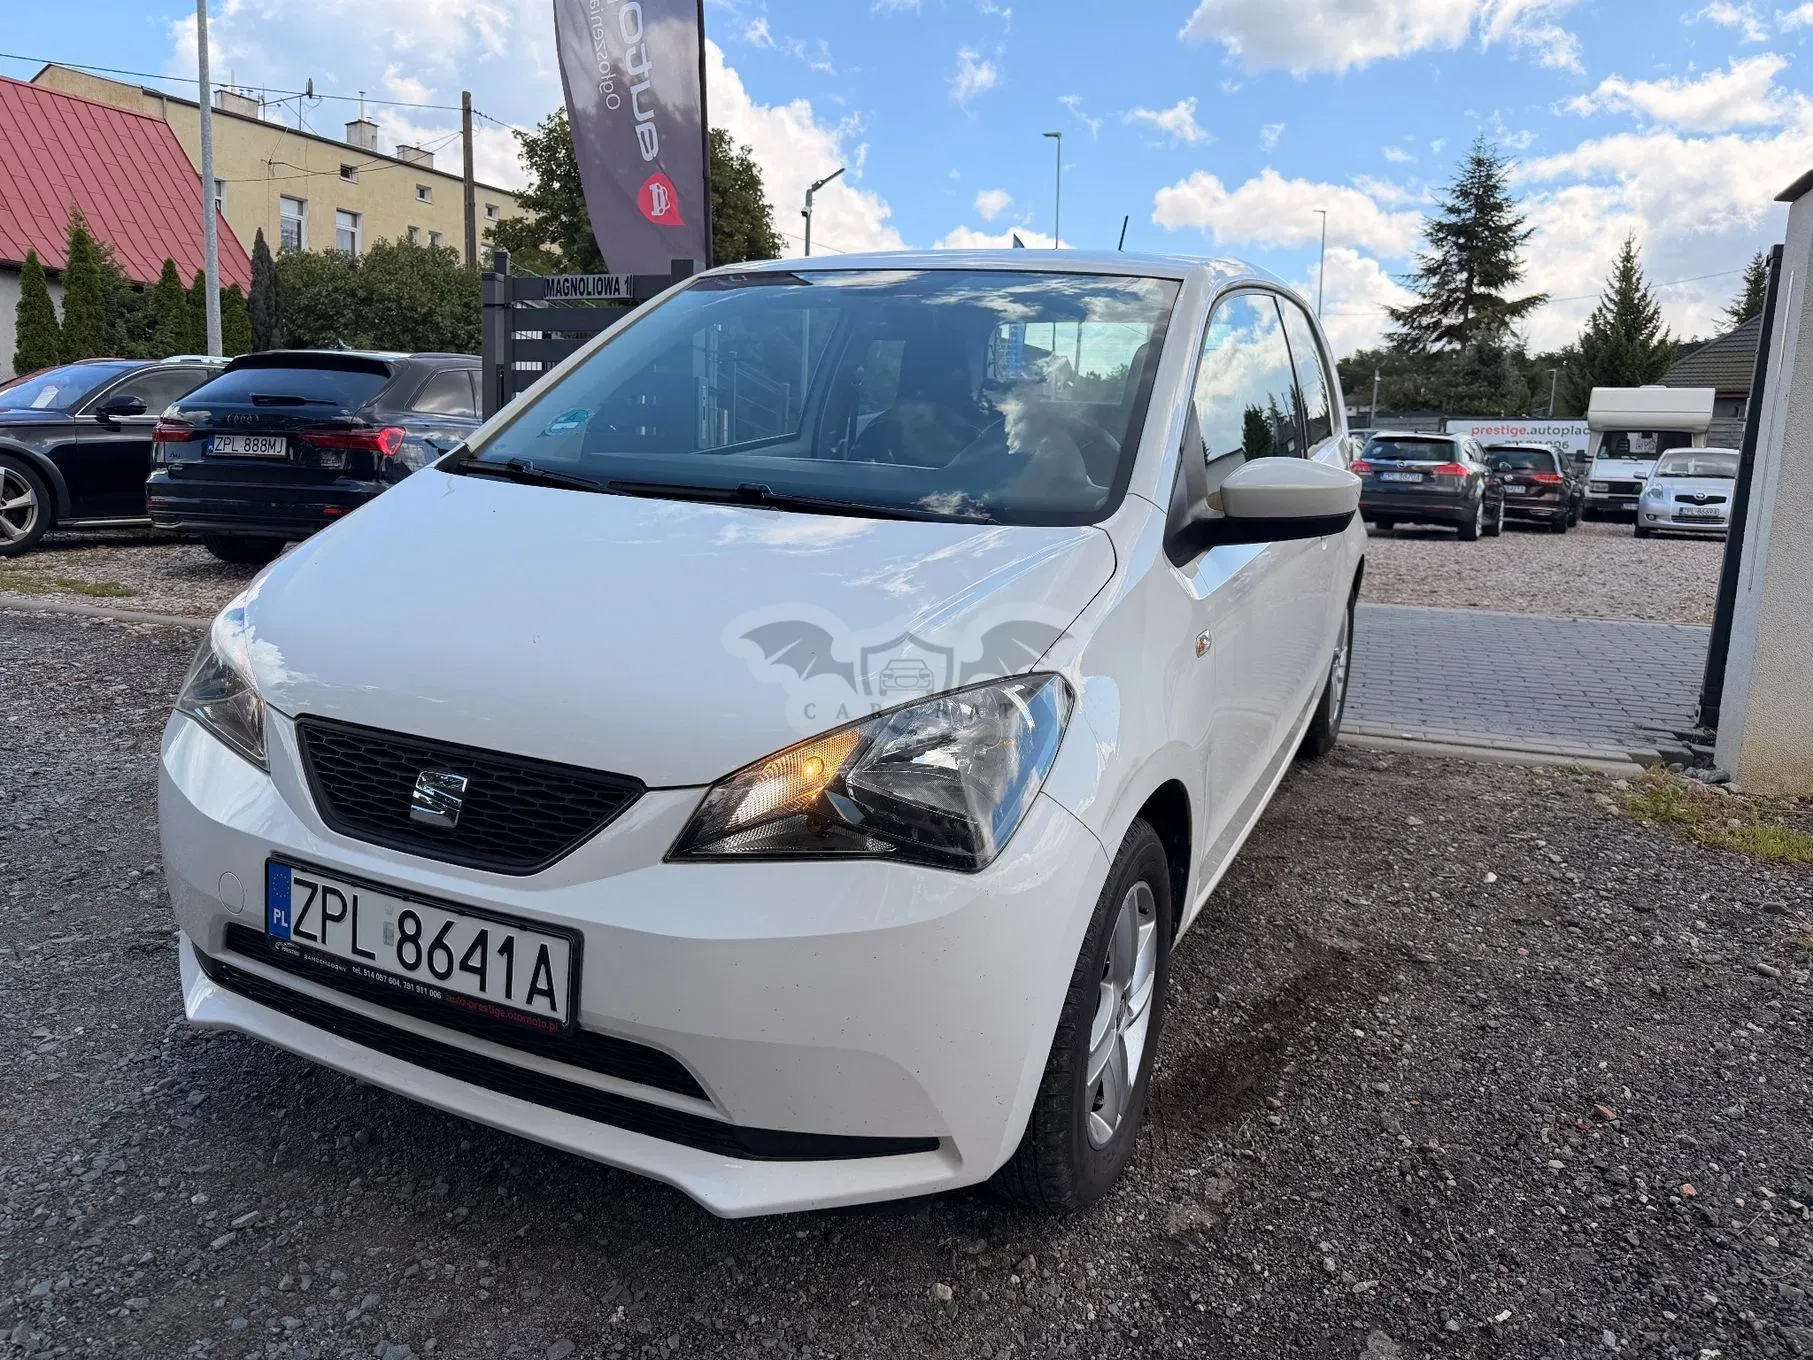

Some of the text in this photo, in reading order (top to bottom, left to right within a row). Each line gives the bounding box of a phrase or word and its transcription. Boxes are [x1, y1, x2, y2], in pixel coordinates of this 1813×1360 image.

[546, 276, 620, 297] MAGNOLIOWA
[214, 436, 284, 454] ZPL 888MJ
[273, 907, 289, 928] PL
[293, 876, 558, 1013] ZPL 8641A
[363, 969, 375, 980] 514
[375, 972, 387, 983] 057
[402, 980, 415, 992] 791
[415, 984, 428, 996] 911
[429, 988, 442, 1000] 006
